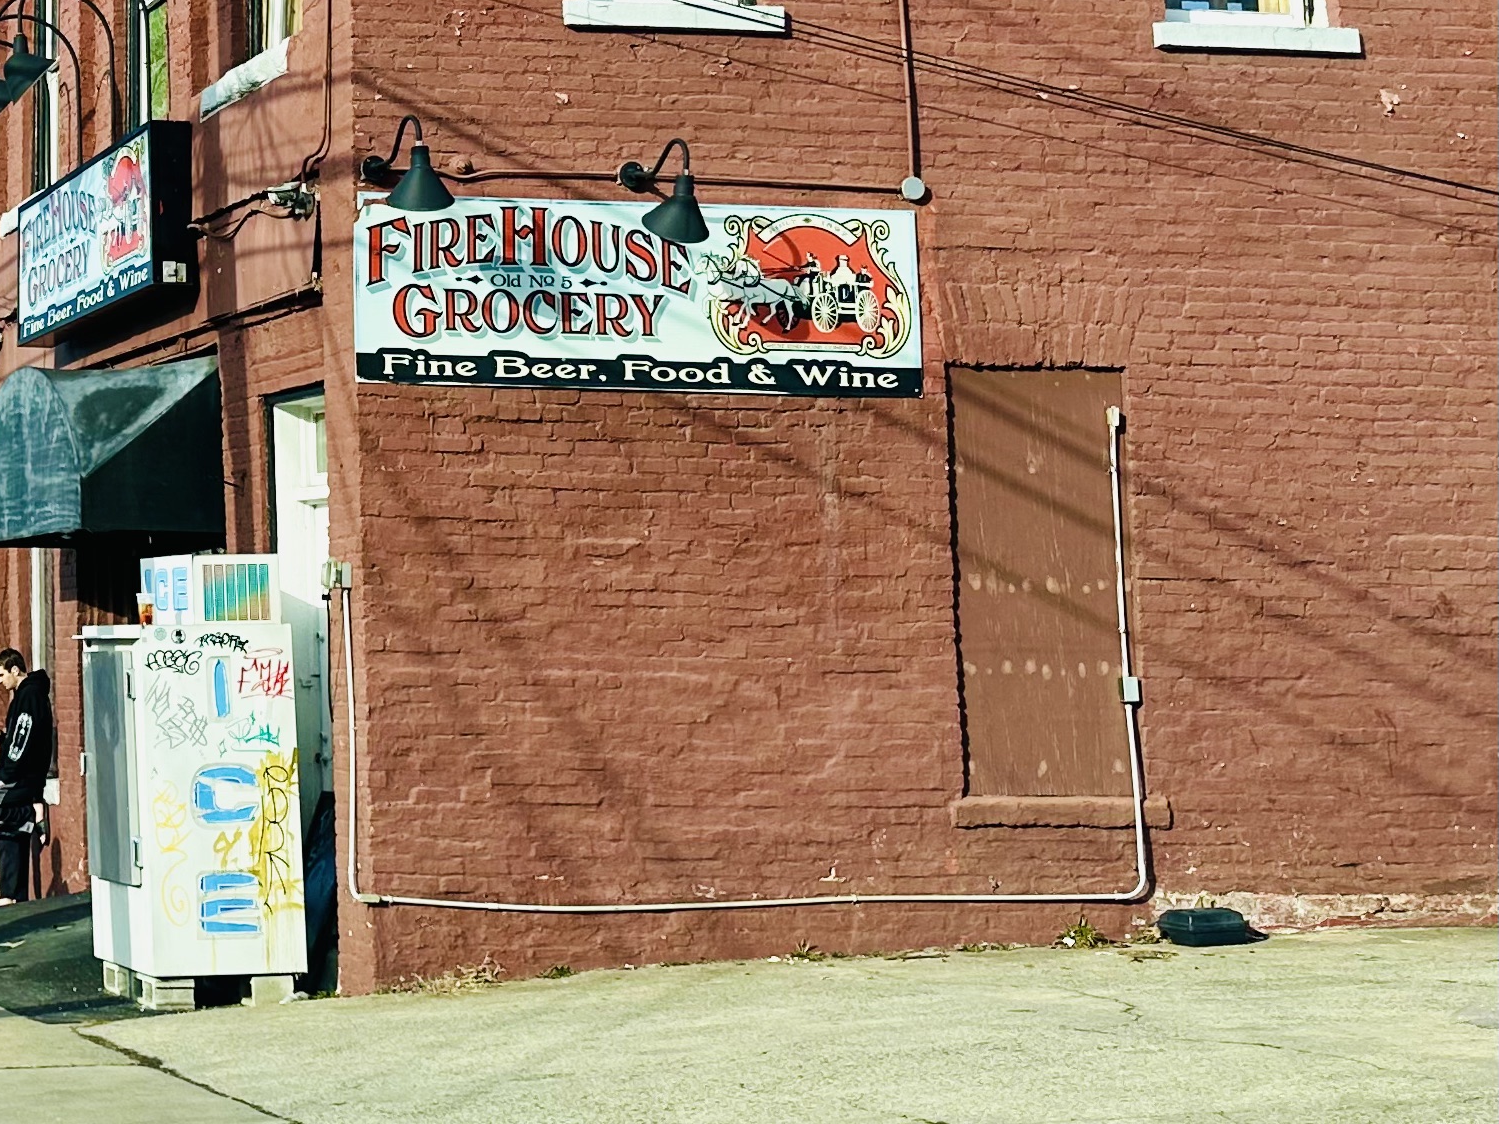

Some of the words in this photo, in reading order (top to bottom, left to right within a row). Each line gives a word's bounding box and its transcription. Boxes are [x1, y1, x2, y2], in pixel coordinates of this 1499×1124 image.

[27, 238, 92, 307] GROCERY
[490, 273, 522, 288] Old
[561, 276, 573, 290] 5
[22, 320, 45, 338] Fine
[76, 285, 104, 313] Food
[106, 280, 116, 298] &
[118, 267, 149, 292] Wine
[392, 283, 665, 339] GROCERY
[382, 353, 479, 378] Fine
[494, 355, 608, 383] Beer,
[622, 359, 730, 384] Food
[747, 363, 777, 386] &
[794, 363, 900, 389] Wine
[144, 566, 189, 612] ICE
